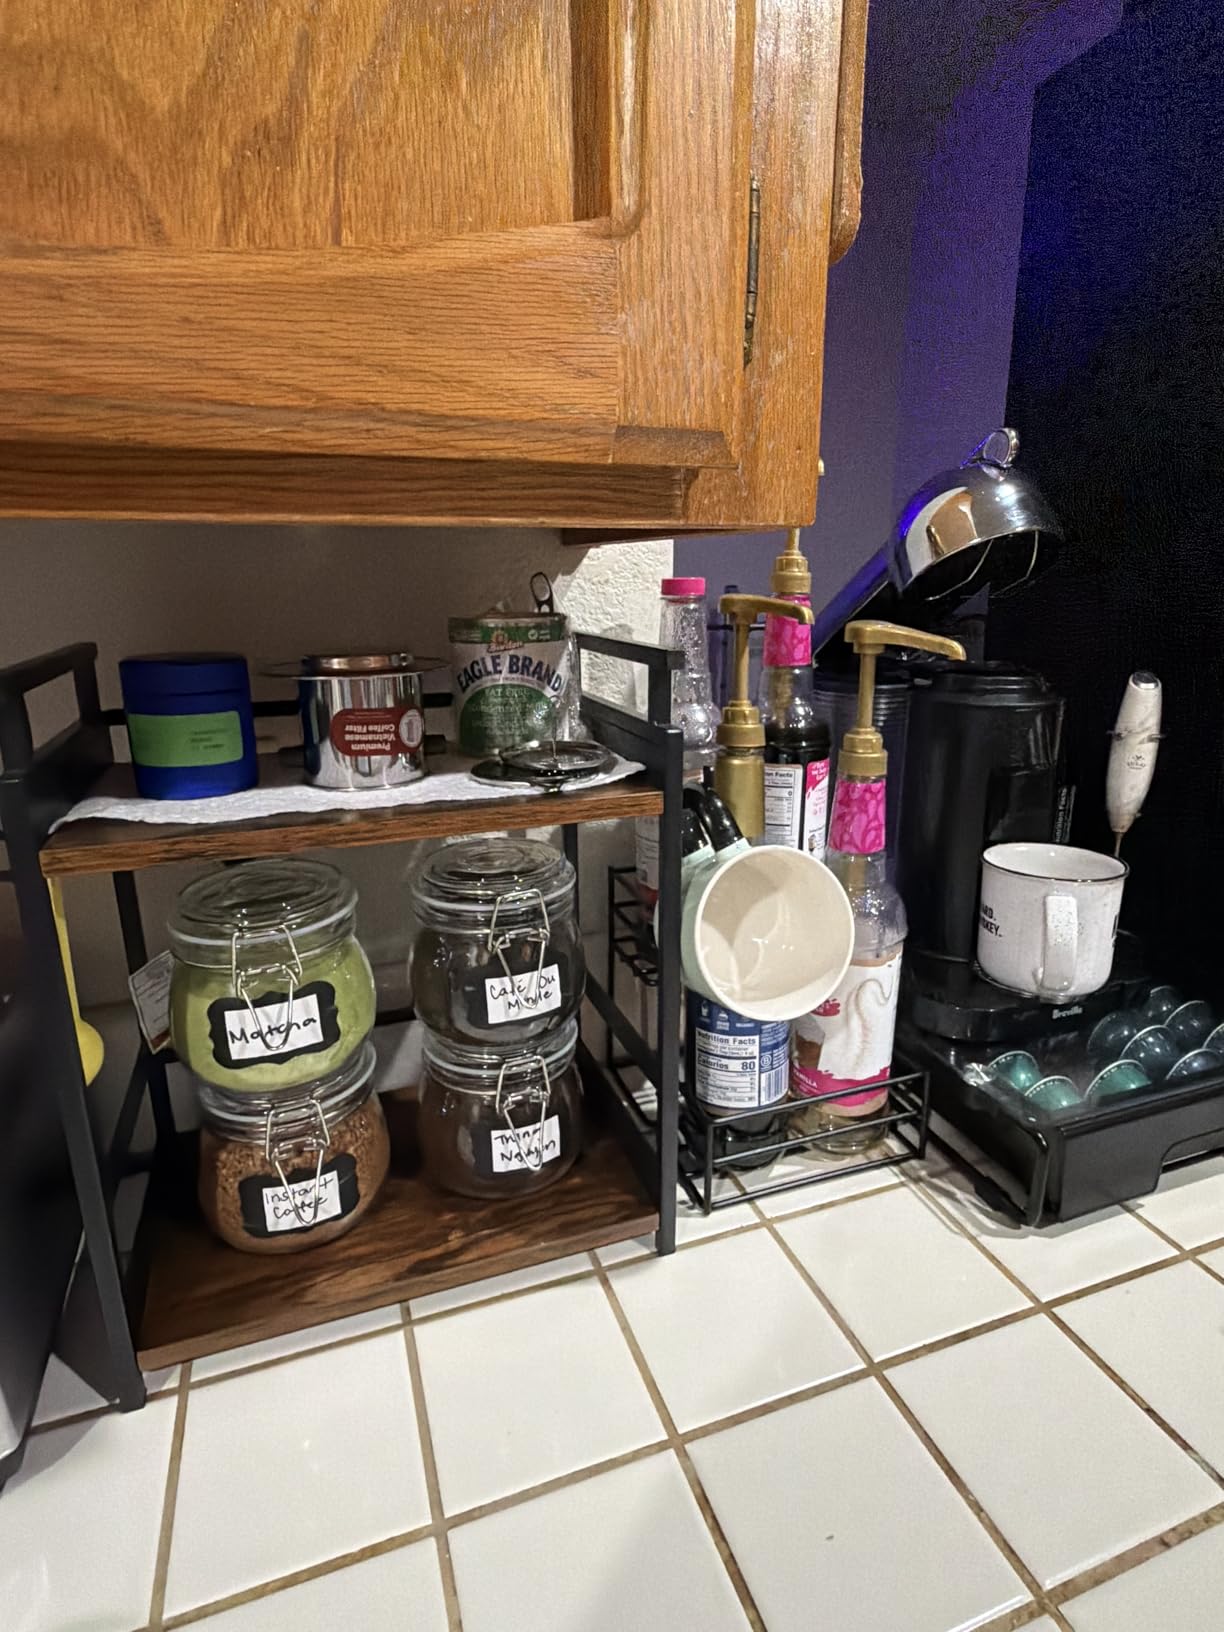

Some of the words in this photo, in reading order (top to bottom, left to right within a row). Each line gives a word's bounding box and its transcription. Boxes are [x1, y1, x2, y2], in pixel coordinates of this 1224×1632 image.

[456, 654, 502, 693] EAGLE
[508, 654, 563, 692] BRAND
[344, 724, 367, 733] Filter
[368, 724, 395, 732] Coffee
[344, 733, 396, 741] Vietnamese
[351, 742, 392, 751] Premium
[697, 1030, 730, 1044] Nutrition
[732, 1037, 757, 1045] Facts
[697, 1055, 729, 1070] Calories
[741, 1061, 756, 1071] 80
[500, 1140, 556, 1163] Nguyn
[273, 1198, 328, 1220] Cofee
